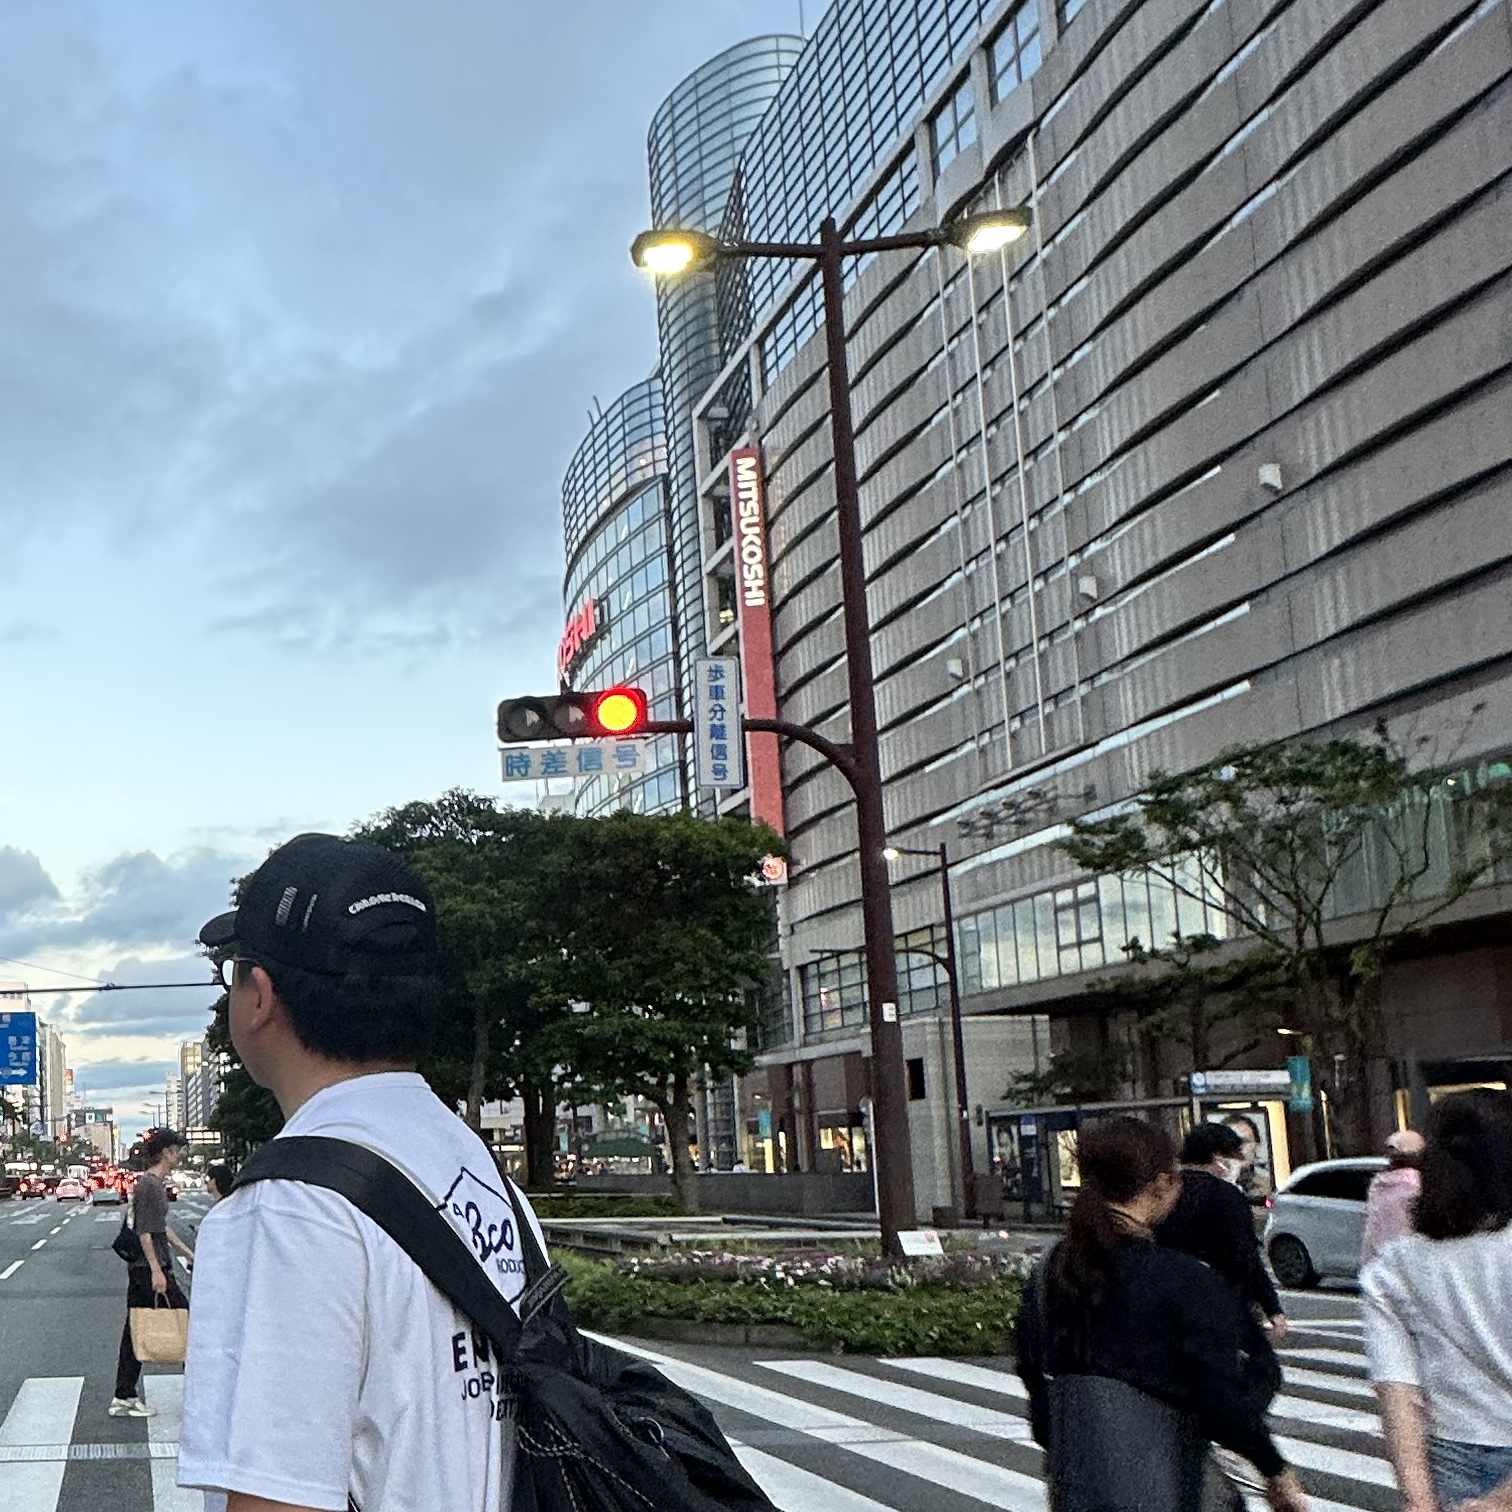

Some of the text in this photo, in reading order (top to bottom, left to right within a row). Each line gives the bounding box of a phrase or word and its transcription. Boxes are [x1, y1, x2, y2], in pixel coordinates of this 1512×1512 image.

[735, 456, 766, 607] MITSUKOSHI
[505, 743, 640, 777] 時差信号
[707, 663, 729, 781] 歩車分離信号
